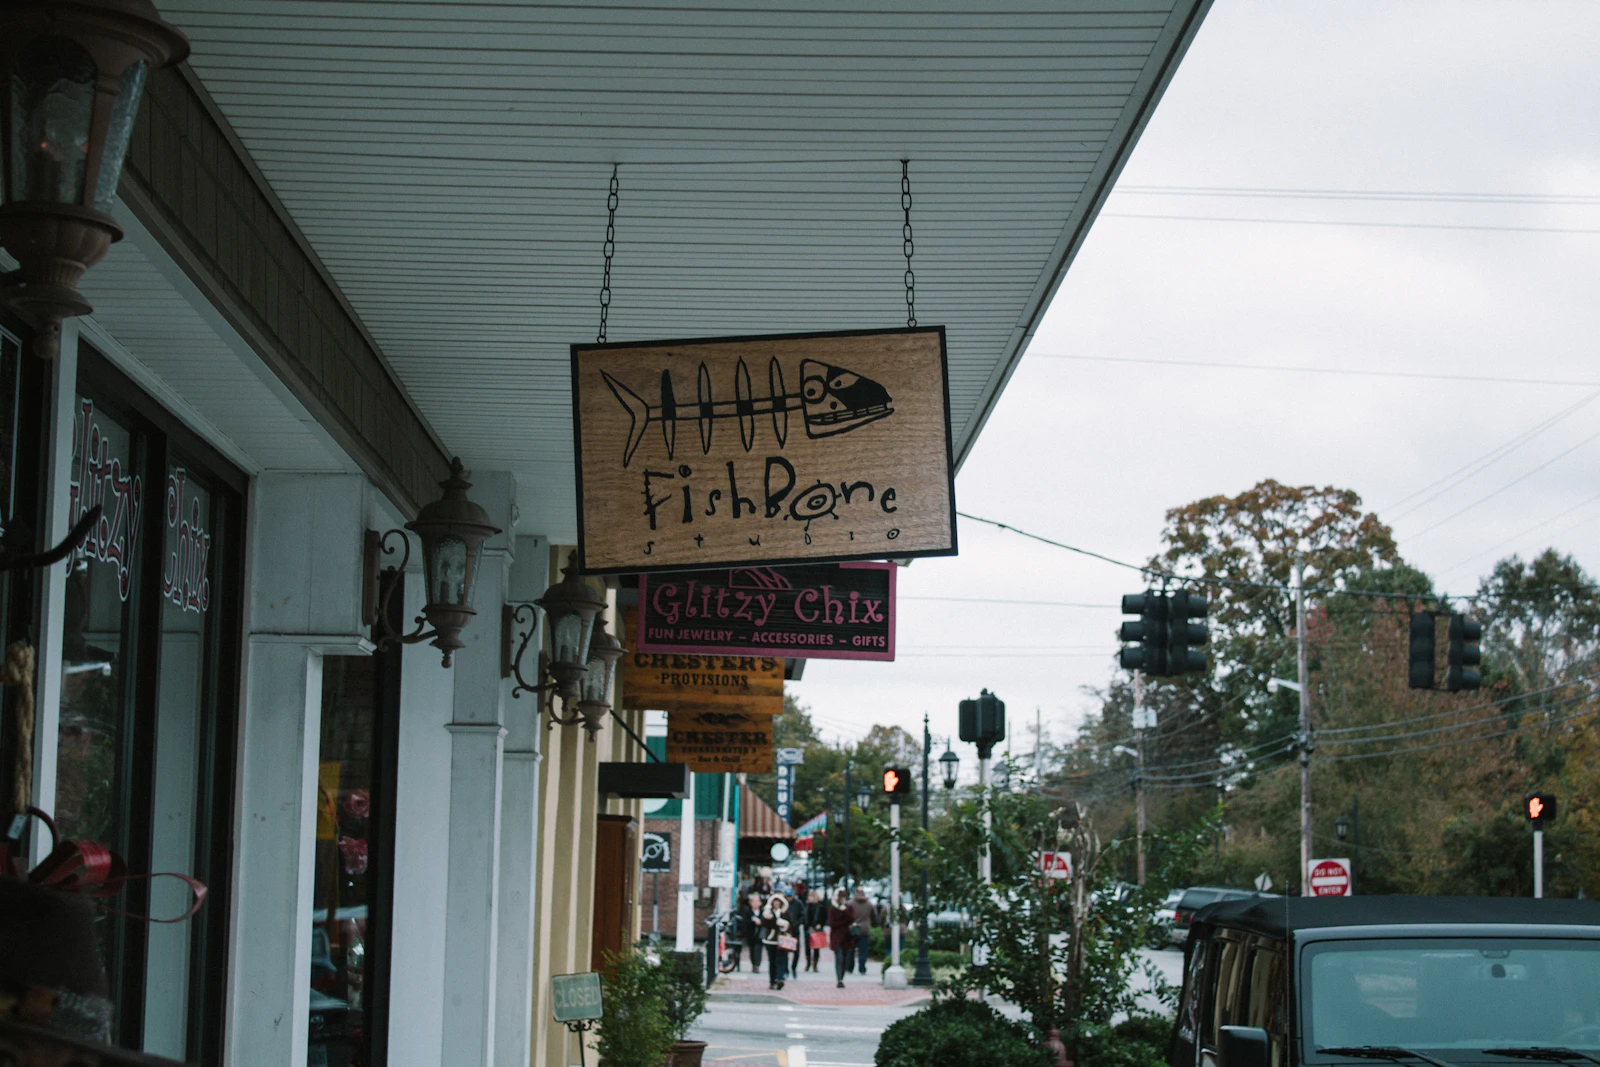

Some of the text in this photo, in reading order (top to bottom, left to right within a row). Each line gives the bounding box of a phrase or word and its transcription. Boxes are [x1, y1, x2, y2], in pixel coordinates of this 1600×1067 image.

[652, 579, 885, 627] Glitzy Chix
[648, 627, 675, 640] FUN
[677, 629, 733, 642] JEWELRY
[752, 631, 834, 646] ACCESSORIES
[852, 635, 886, 648] GIFTS
[660, 672, 748, 687] PROVISIONS
[672, 731, 768, 745] CHESTER
[777, 765, 788, 822] DRUG
